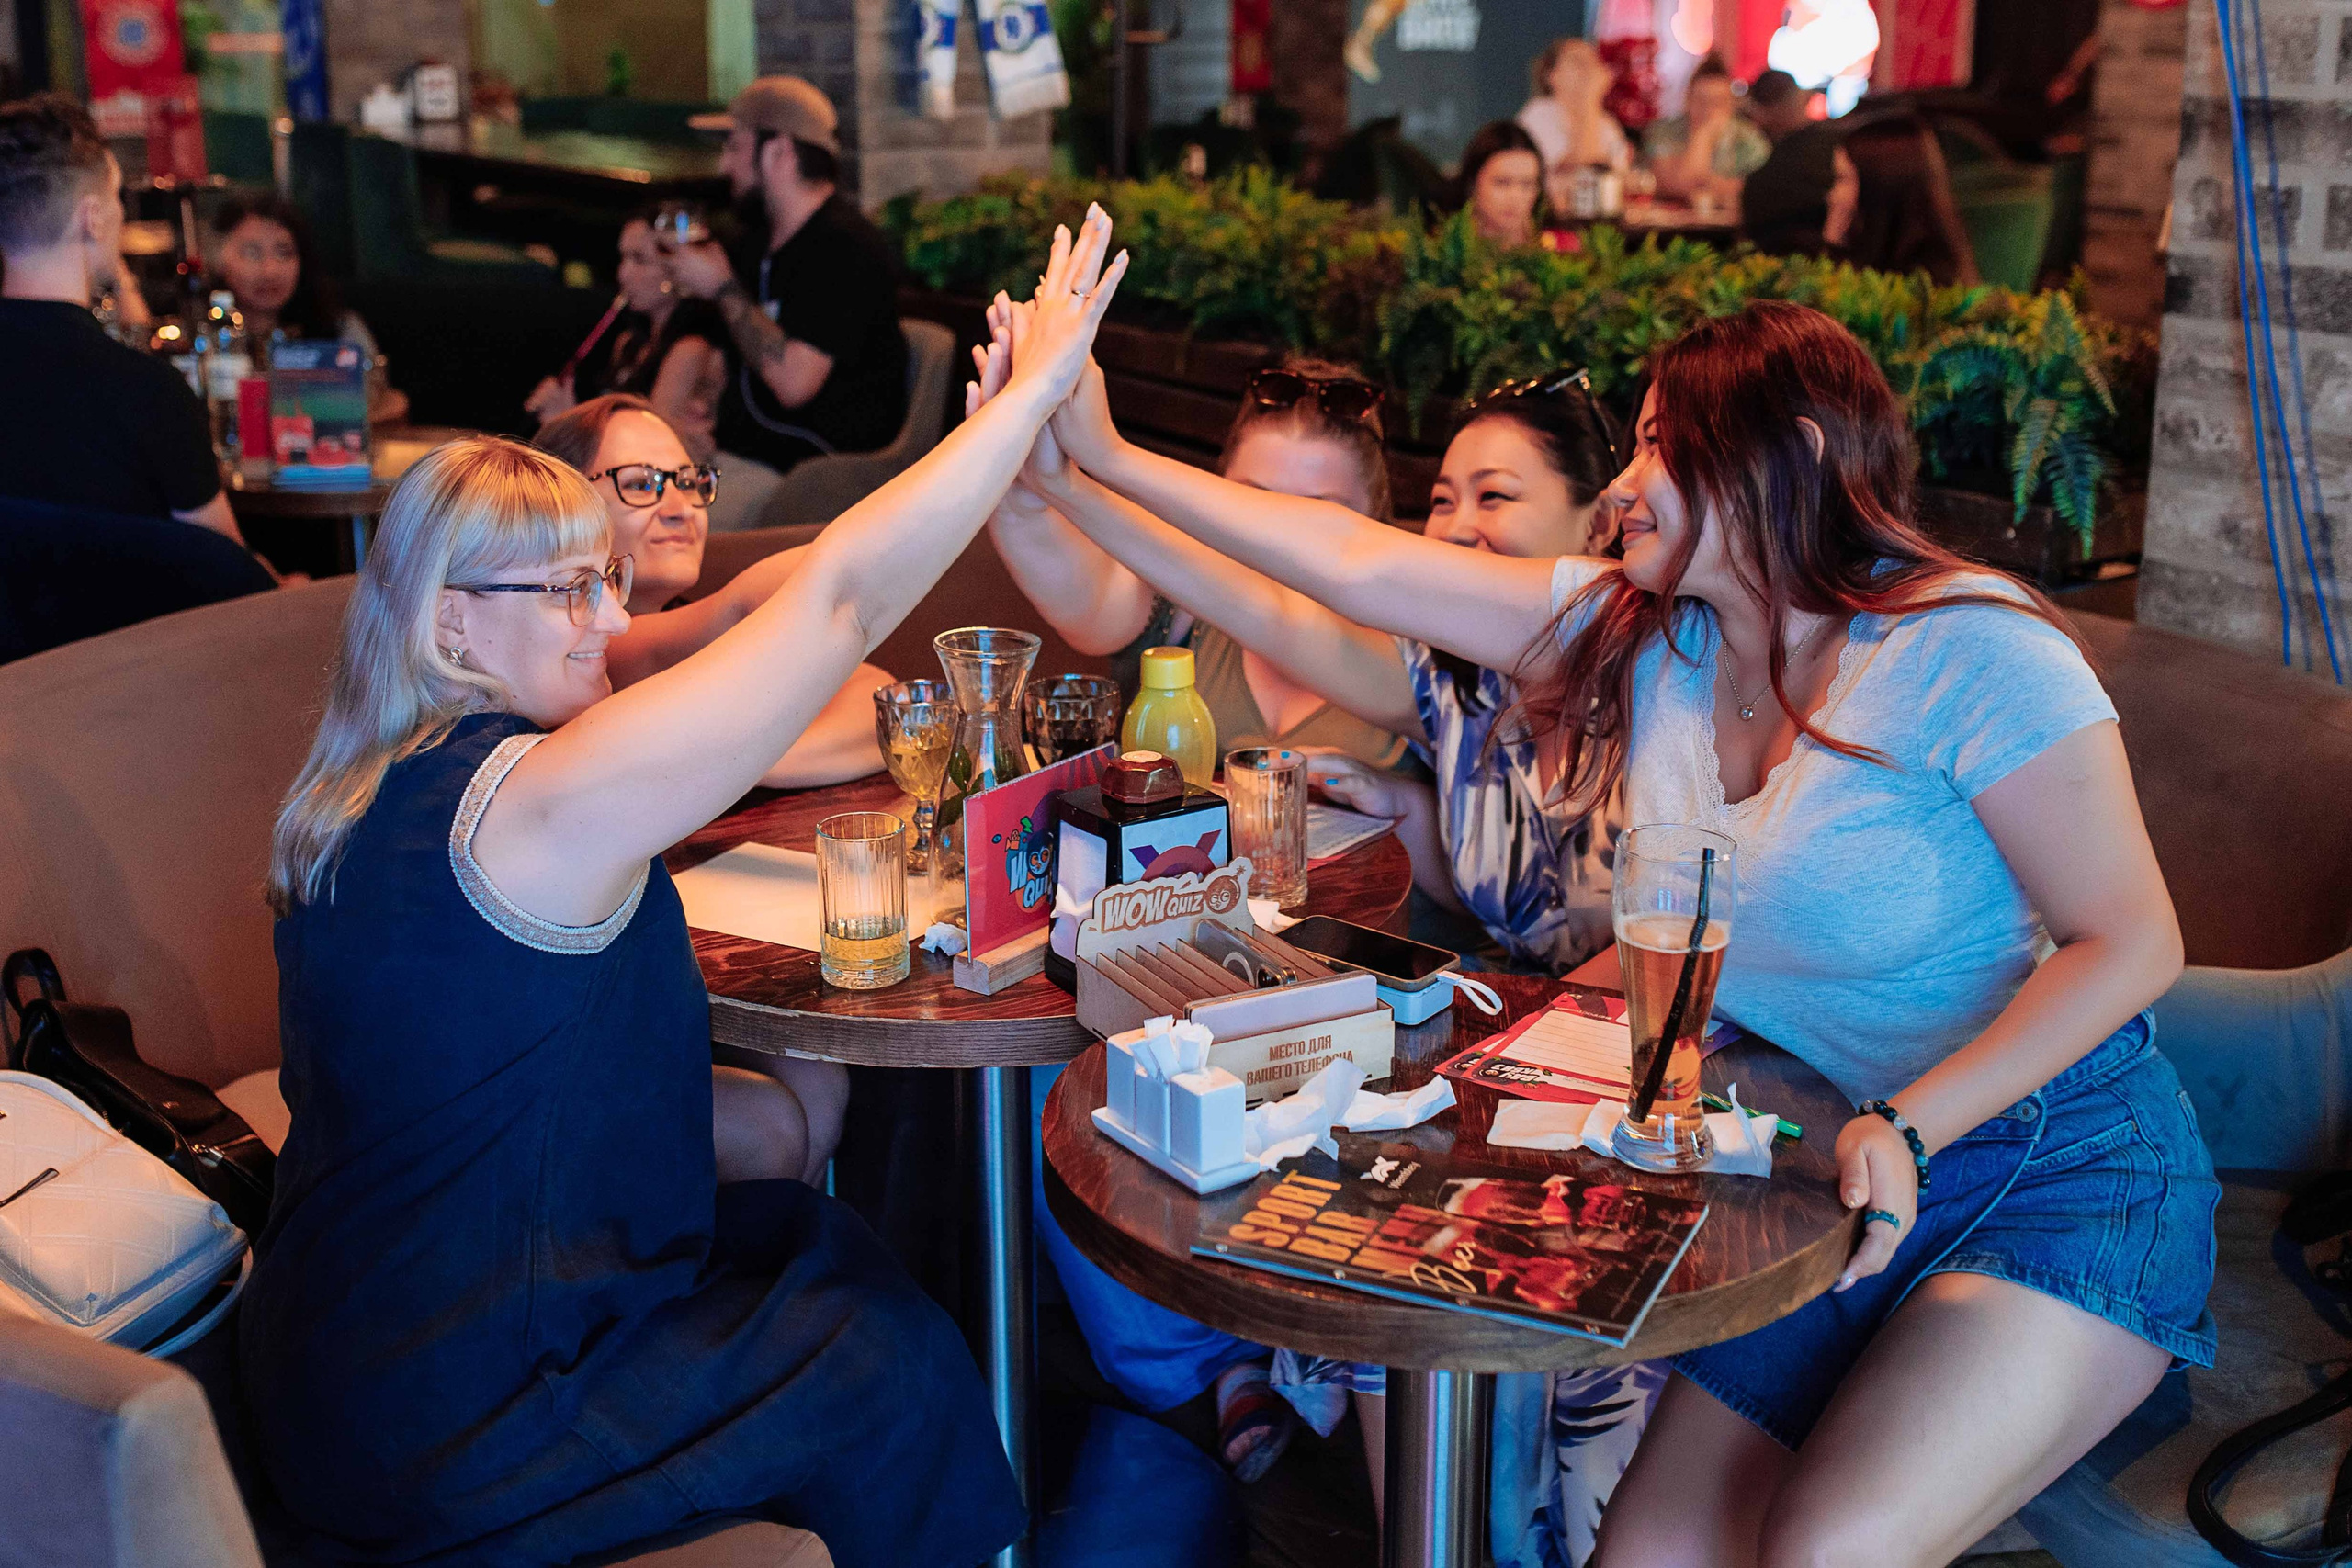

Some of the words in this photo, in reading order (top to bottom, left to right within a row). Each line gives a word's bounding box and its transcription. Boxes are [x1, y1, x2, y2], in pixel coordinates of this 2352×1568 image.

[1023, 874, 1049, 908] QUI
[1103, 887, 1172, 931] WOW
[1166, 894, 1204, 917] QUIZ
[1246, 1065, 1292, 1085] ВАШЕГО
[1292, 1050, 1354, 1076] ТЕЛЕФА
[1269, 1040, 1306, 1061] МЕСТО
[1307, 1035, 1332, 1055] ДЛЯ
[1228, 1169, 1342, 1247] SPORT
[1288, 1211, 1378, 1262] BAR
